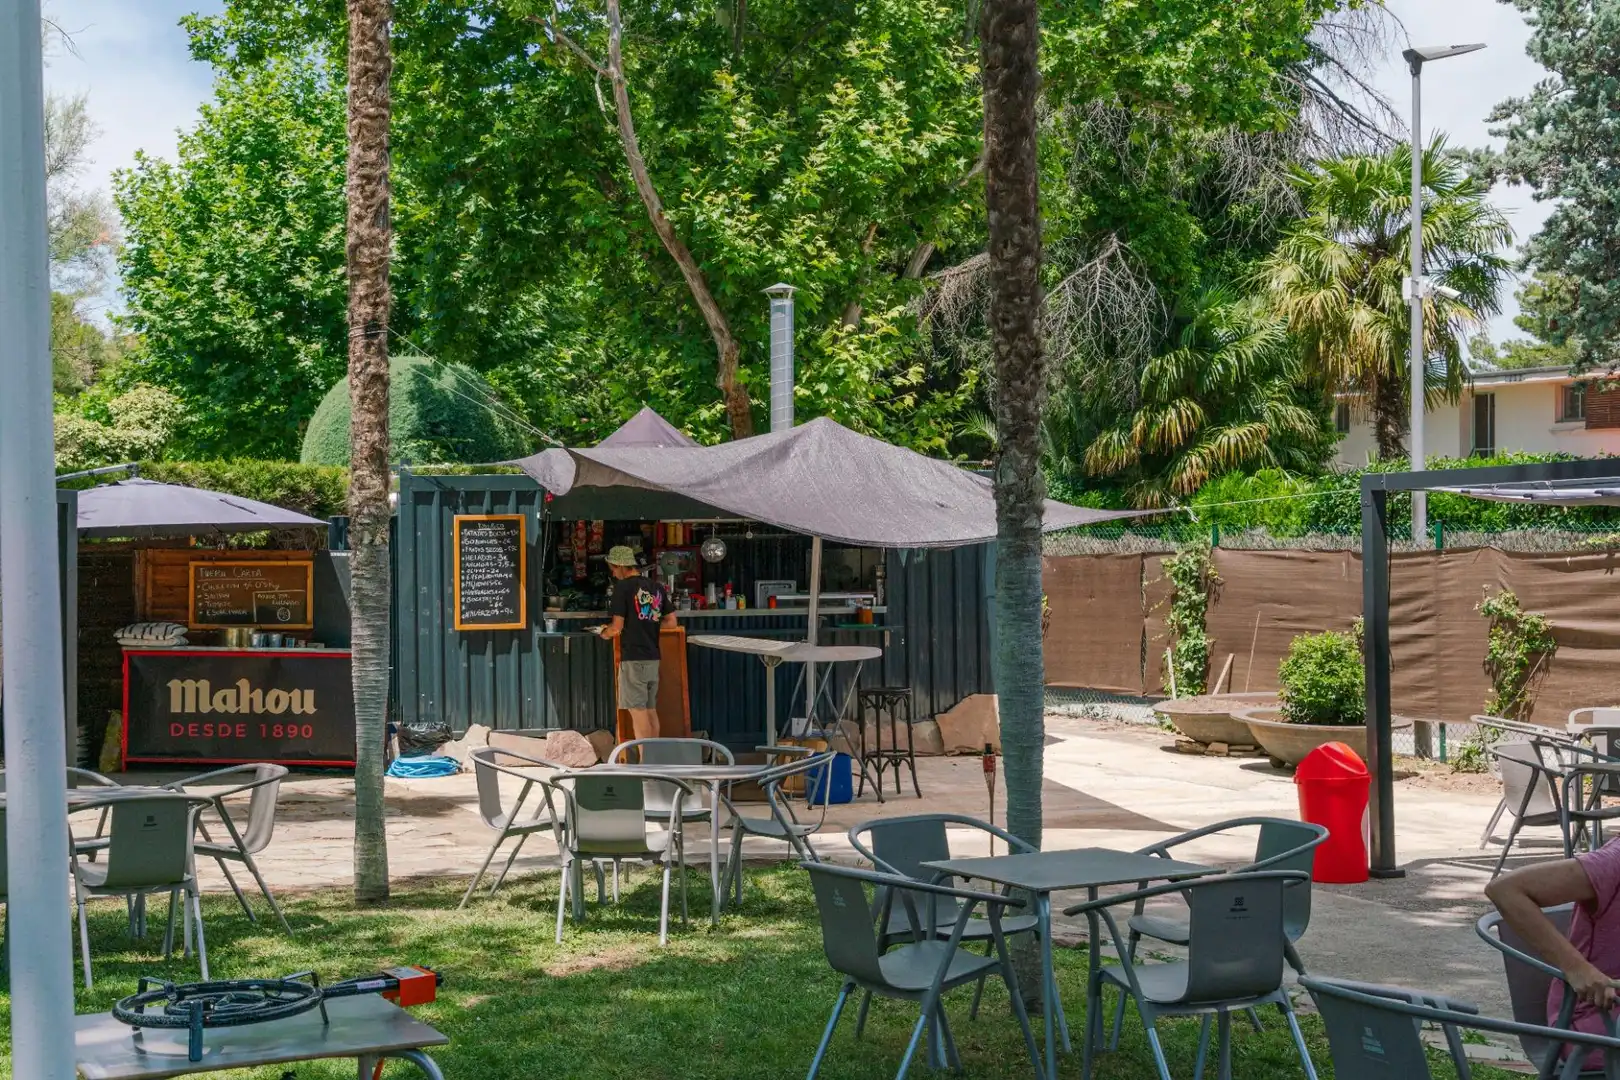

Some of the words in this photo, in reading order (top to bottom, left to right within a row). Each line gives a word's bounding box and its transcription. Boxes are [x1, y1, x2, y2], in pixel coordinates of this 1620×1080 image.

[167, 678, 318, 714] Mahou
[171, 724, 247, 738] DESDE
[260, 724, 313, 738] 1890
